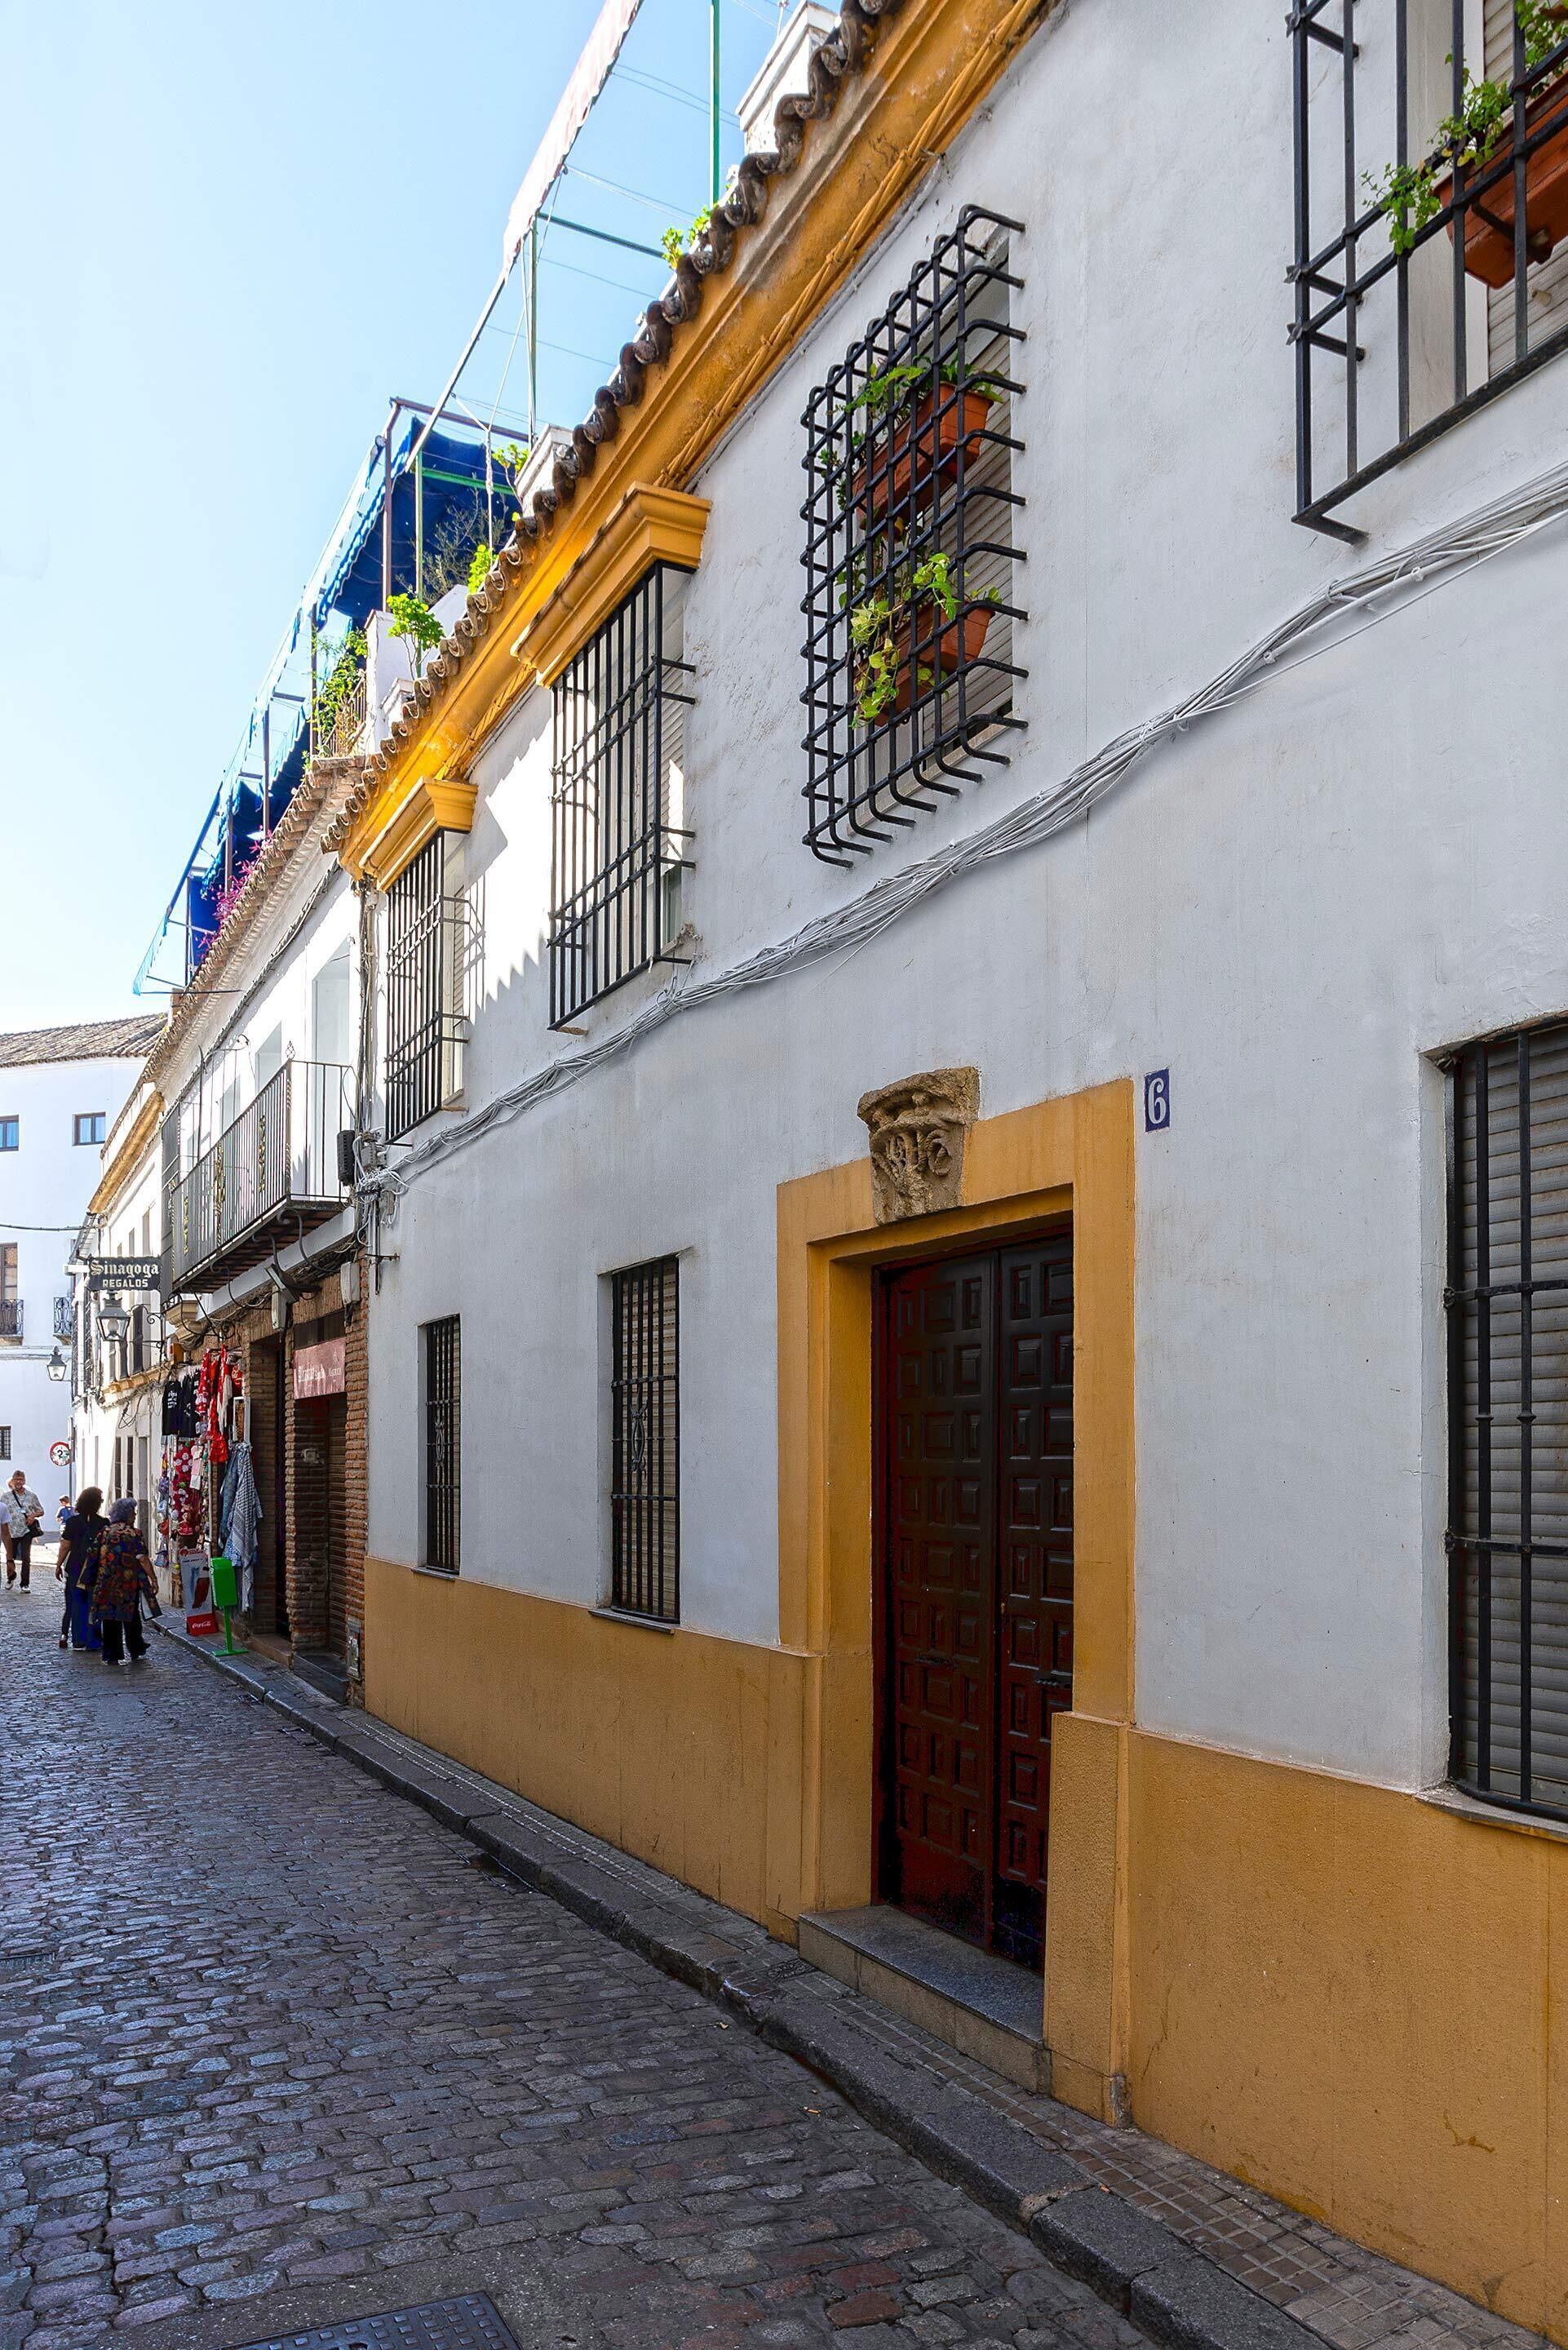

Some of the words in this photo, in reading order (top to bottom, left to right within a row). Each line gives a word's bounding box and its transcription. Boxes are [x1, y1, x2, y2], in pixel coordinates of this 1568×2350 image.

[1148, 1077, 1167, 1124] 6
[91, 1259, 160, 1278] Sinagoga
[103, 1279, 148, 1288] REGALOS
